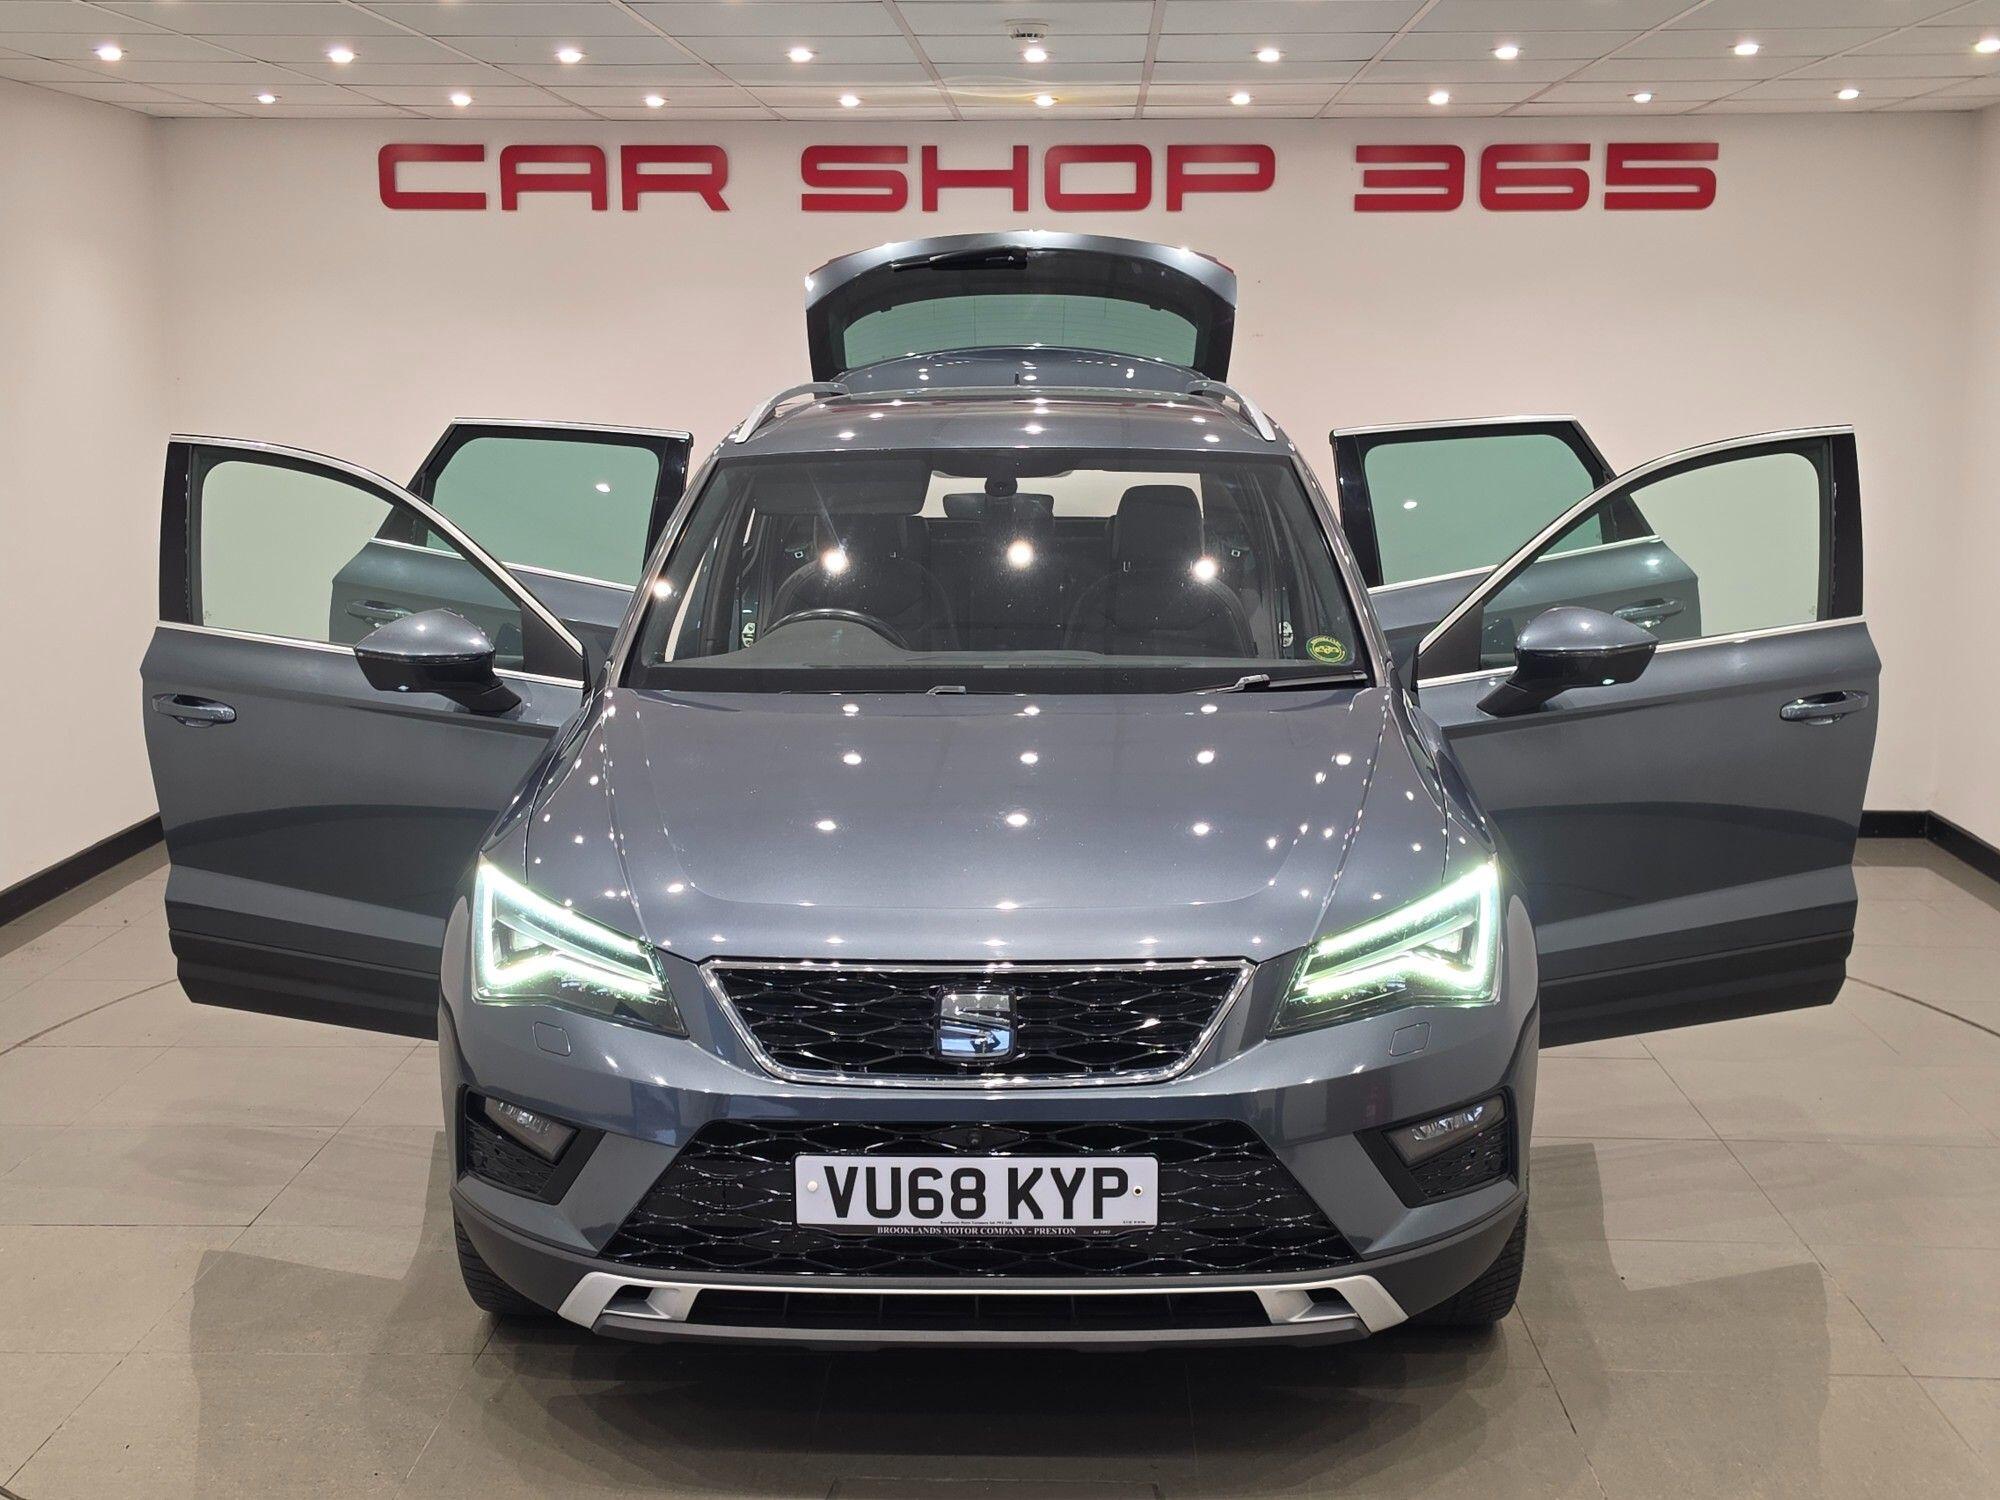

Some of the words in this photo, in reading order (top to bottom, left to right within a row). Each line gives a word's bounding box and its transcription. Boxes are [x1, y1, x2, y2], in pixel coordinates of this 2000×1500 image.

[378, 142, 730, 212] CAR
[801, 143, 1276, 213] SHOP
[1354, 142, 1720, 212] 365
[823, 1166, 987, 1220] VU68
[1007, 1167, 1130, 1220] KYP
[877, 1227, 942, 1235] BROOKLANDS
[943, 1227, 979, 1235] MOTOR
[980, 1227, 1027, 1236] COMPANY
[1033, 1227, 1077, 1236] PRESTON
